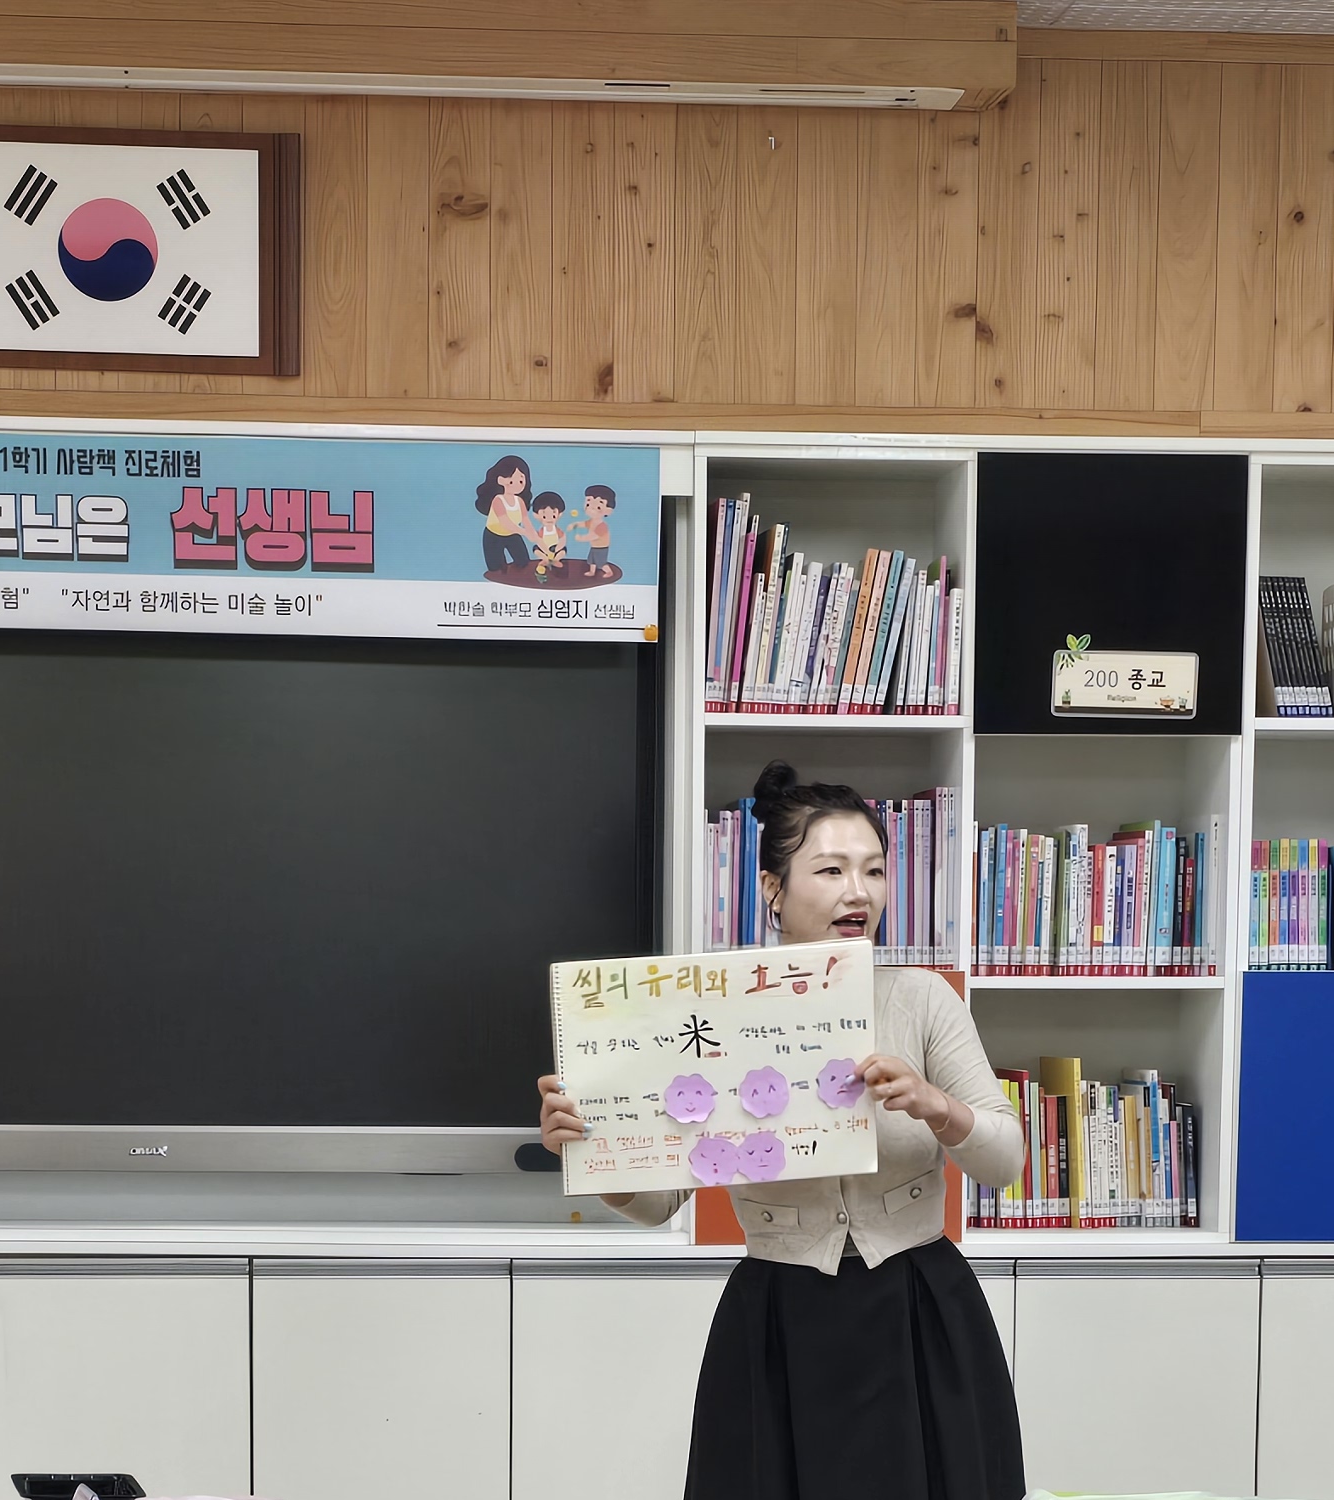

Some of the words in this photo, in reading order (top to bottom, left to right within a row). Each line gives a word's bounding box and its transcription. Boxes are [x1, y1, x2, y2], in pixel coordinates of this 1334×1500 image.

[0, 446, 48, 477] 1학기
[123, 448, 202, 480] 진로체험
[171, 485, 374, 574] 선생님
[140, 590, 220, 615] 함께하는
[228, 592, 267, 617] 미술
[593, 603, 635, 620] 선생님
[1083, 669, 1119, 688] 200
[1128, 668, 1167, 691] 종교
[678, 1014, 721, 1059] 米
